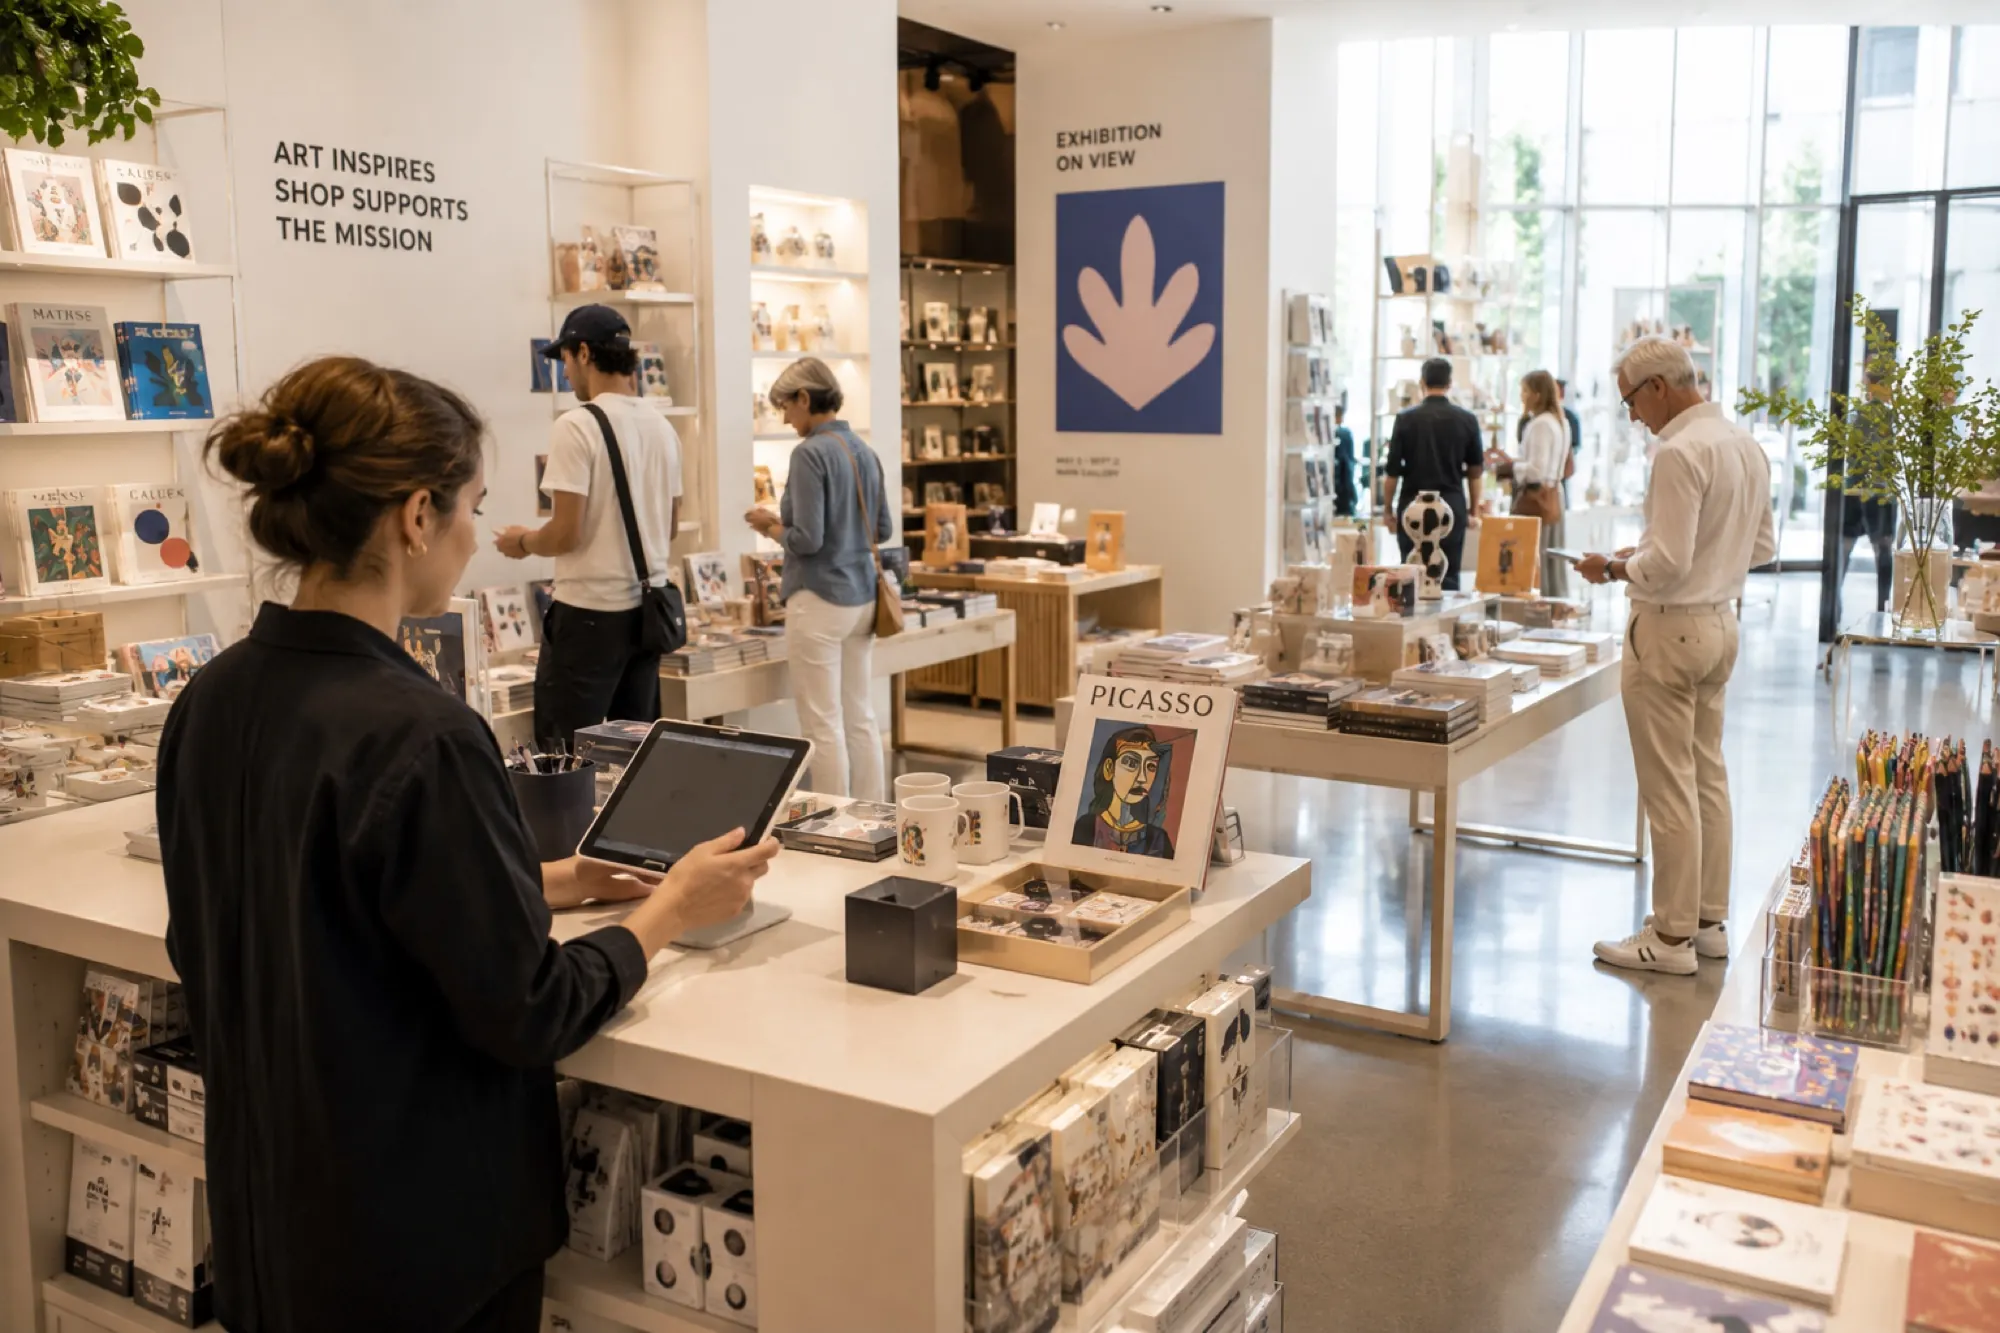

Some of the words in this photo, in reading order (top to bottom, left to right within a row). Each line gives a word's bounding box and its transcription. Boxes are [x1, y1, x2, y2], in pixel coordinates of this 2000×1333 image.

[1056, 123, 1161, 148] EXHIBITION
[274, 141, 324, 169] ART
[332, 147, 436, 184] INSPIRES
[1056, 153, 1083, 172] ON
[1089, 149, 1135, 168] VIEW
[275, 178, 345, 208] SHOP
[352, 187, 469, 221] SUPPORTS
[276, 215, 327, 243] THE
[335, 221, 433, 252] MISSION
[1090, 685, 1213, 717] PICASSO
